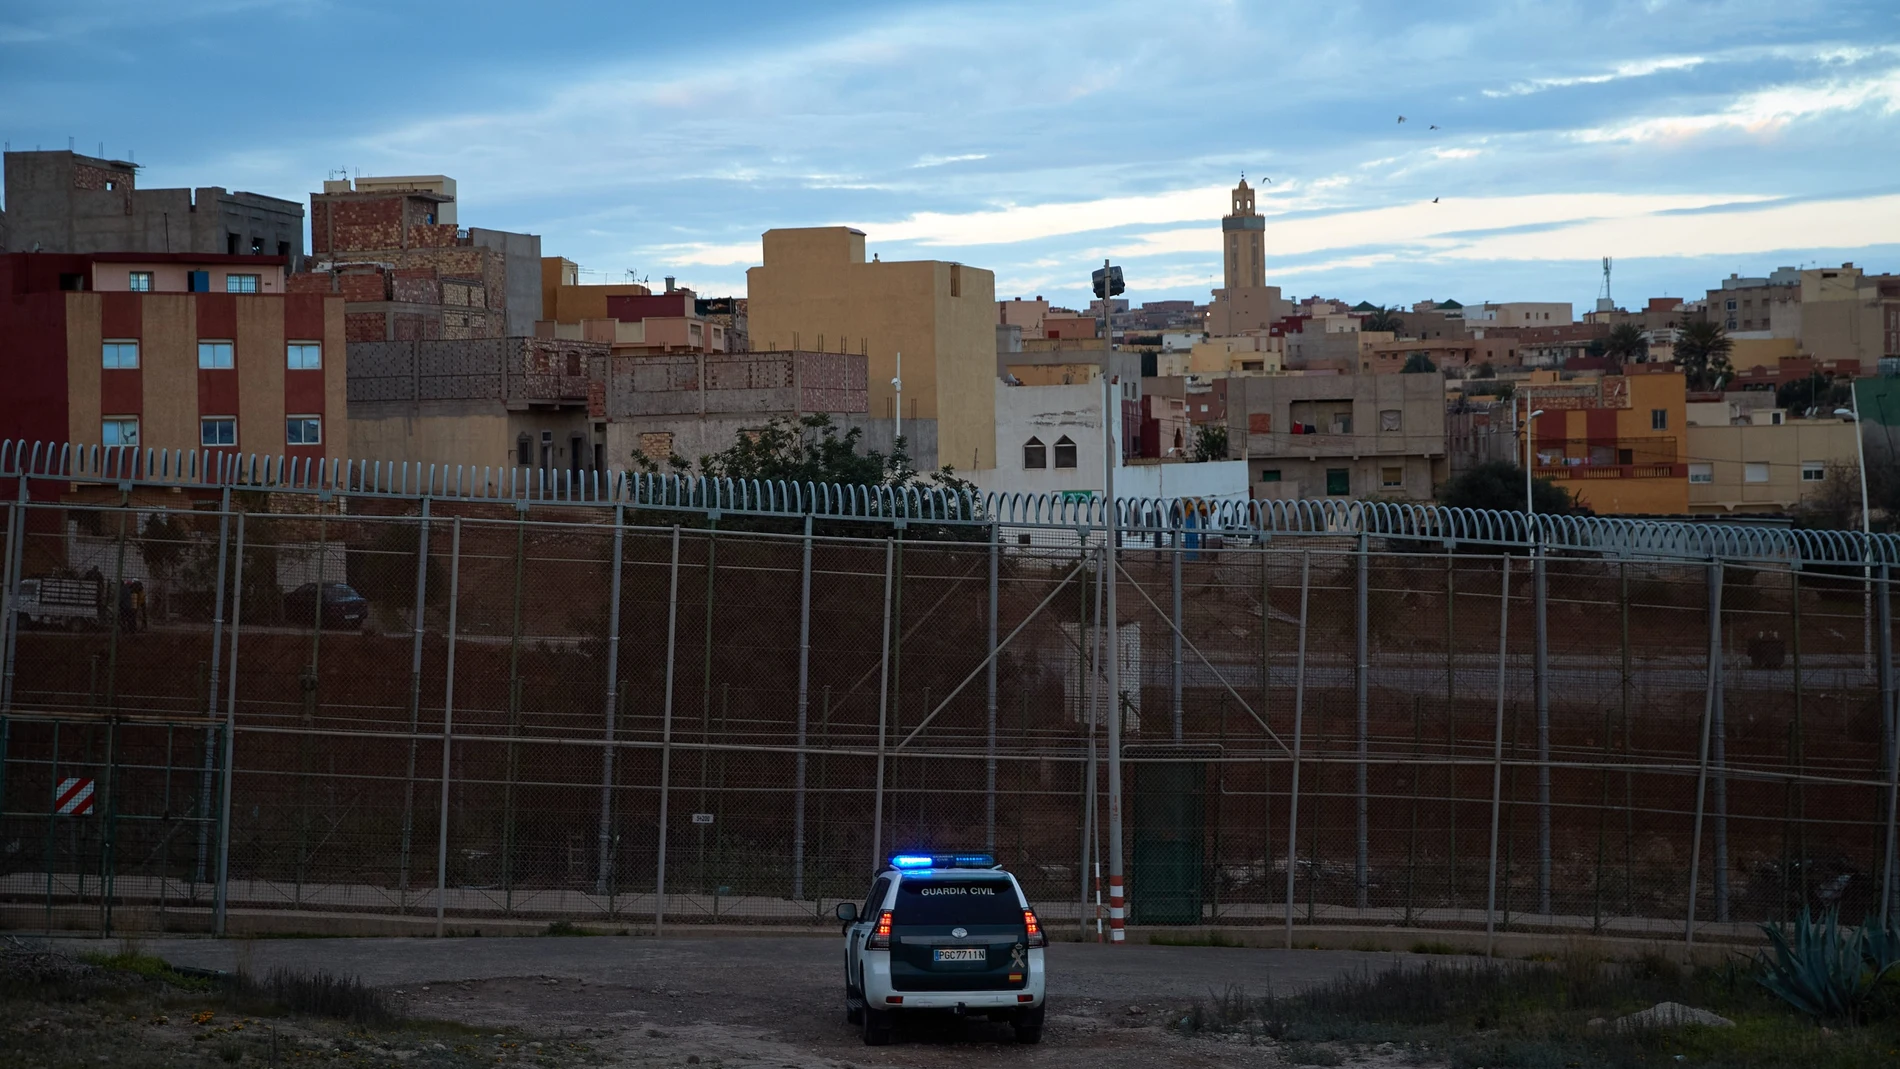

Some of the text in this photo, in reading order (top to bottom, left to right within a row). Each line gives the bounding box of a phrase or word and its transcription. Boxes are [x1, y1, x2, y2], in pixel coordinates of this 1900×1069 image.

[921, 887, 995, 896] GUARDIA CIVIL
[939, 950, 985, 960] PGC7711N
